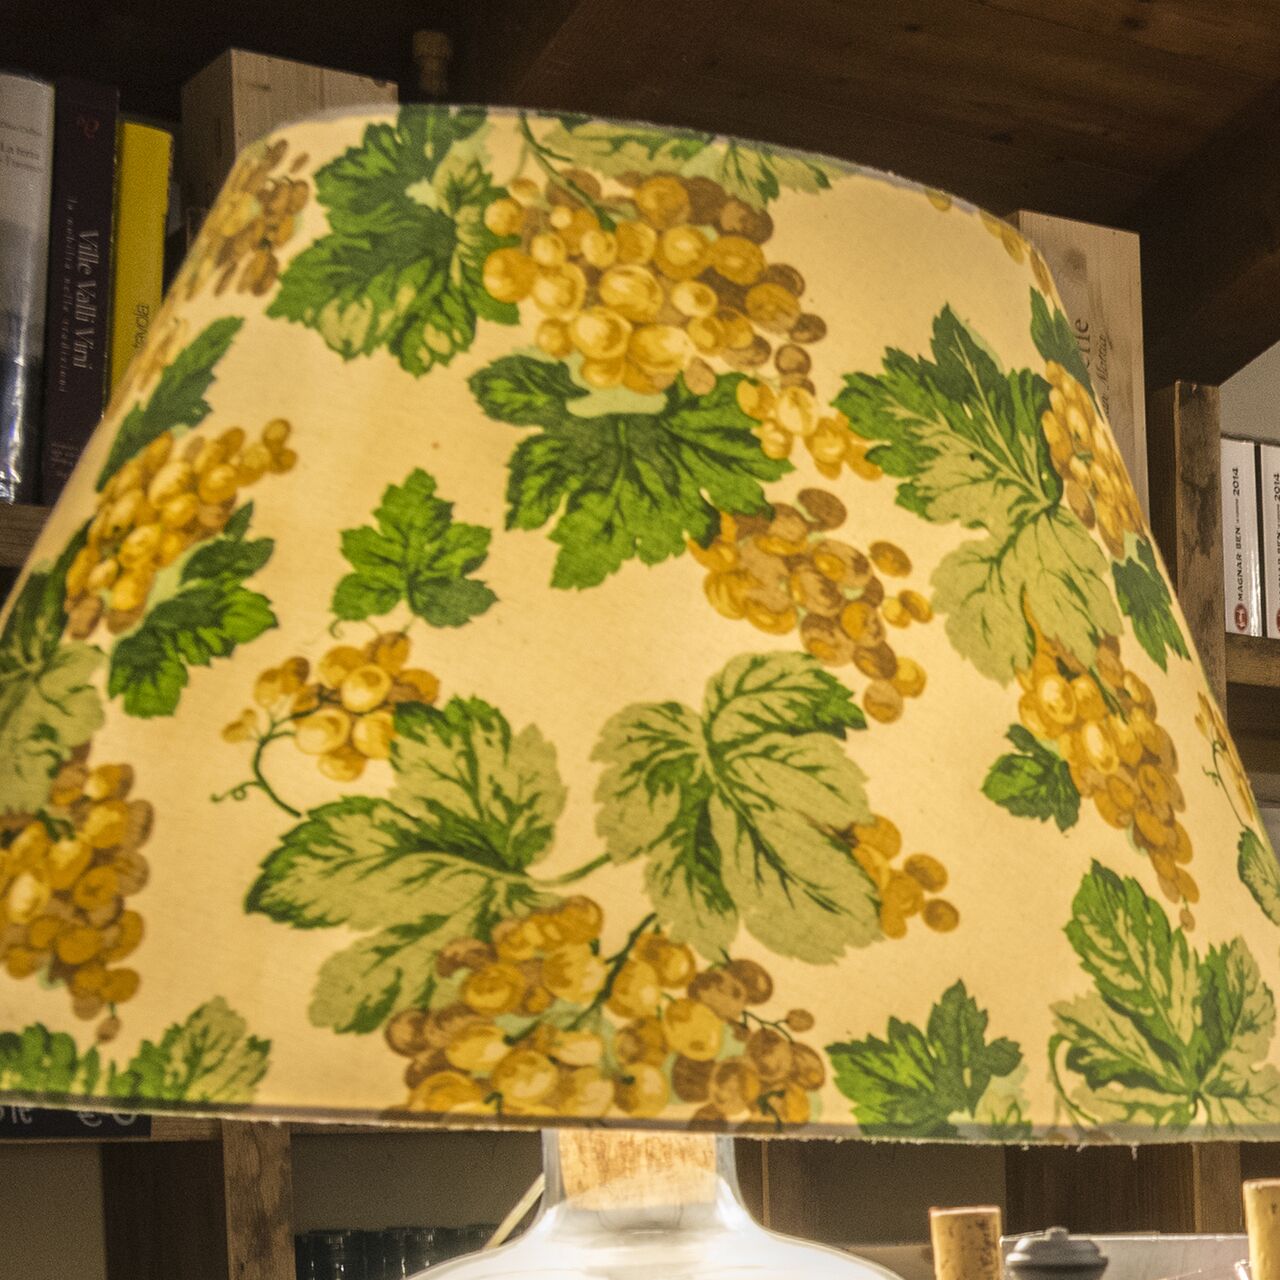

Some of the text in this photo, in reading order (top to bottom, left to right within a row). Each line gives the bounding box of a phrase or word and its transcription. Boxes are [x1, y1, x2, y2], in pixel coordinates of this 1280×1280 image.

[1232, 467, 1241, 497] 2014
[1235, 527, 1243, 550] BEN
[1234, 551, 1244, 602] MAGNAR
